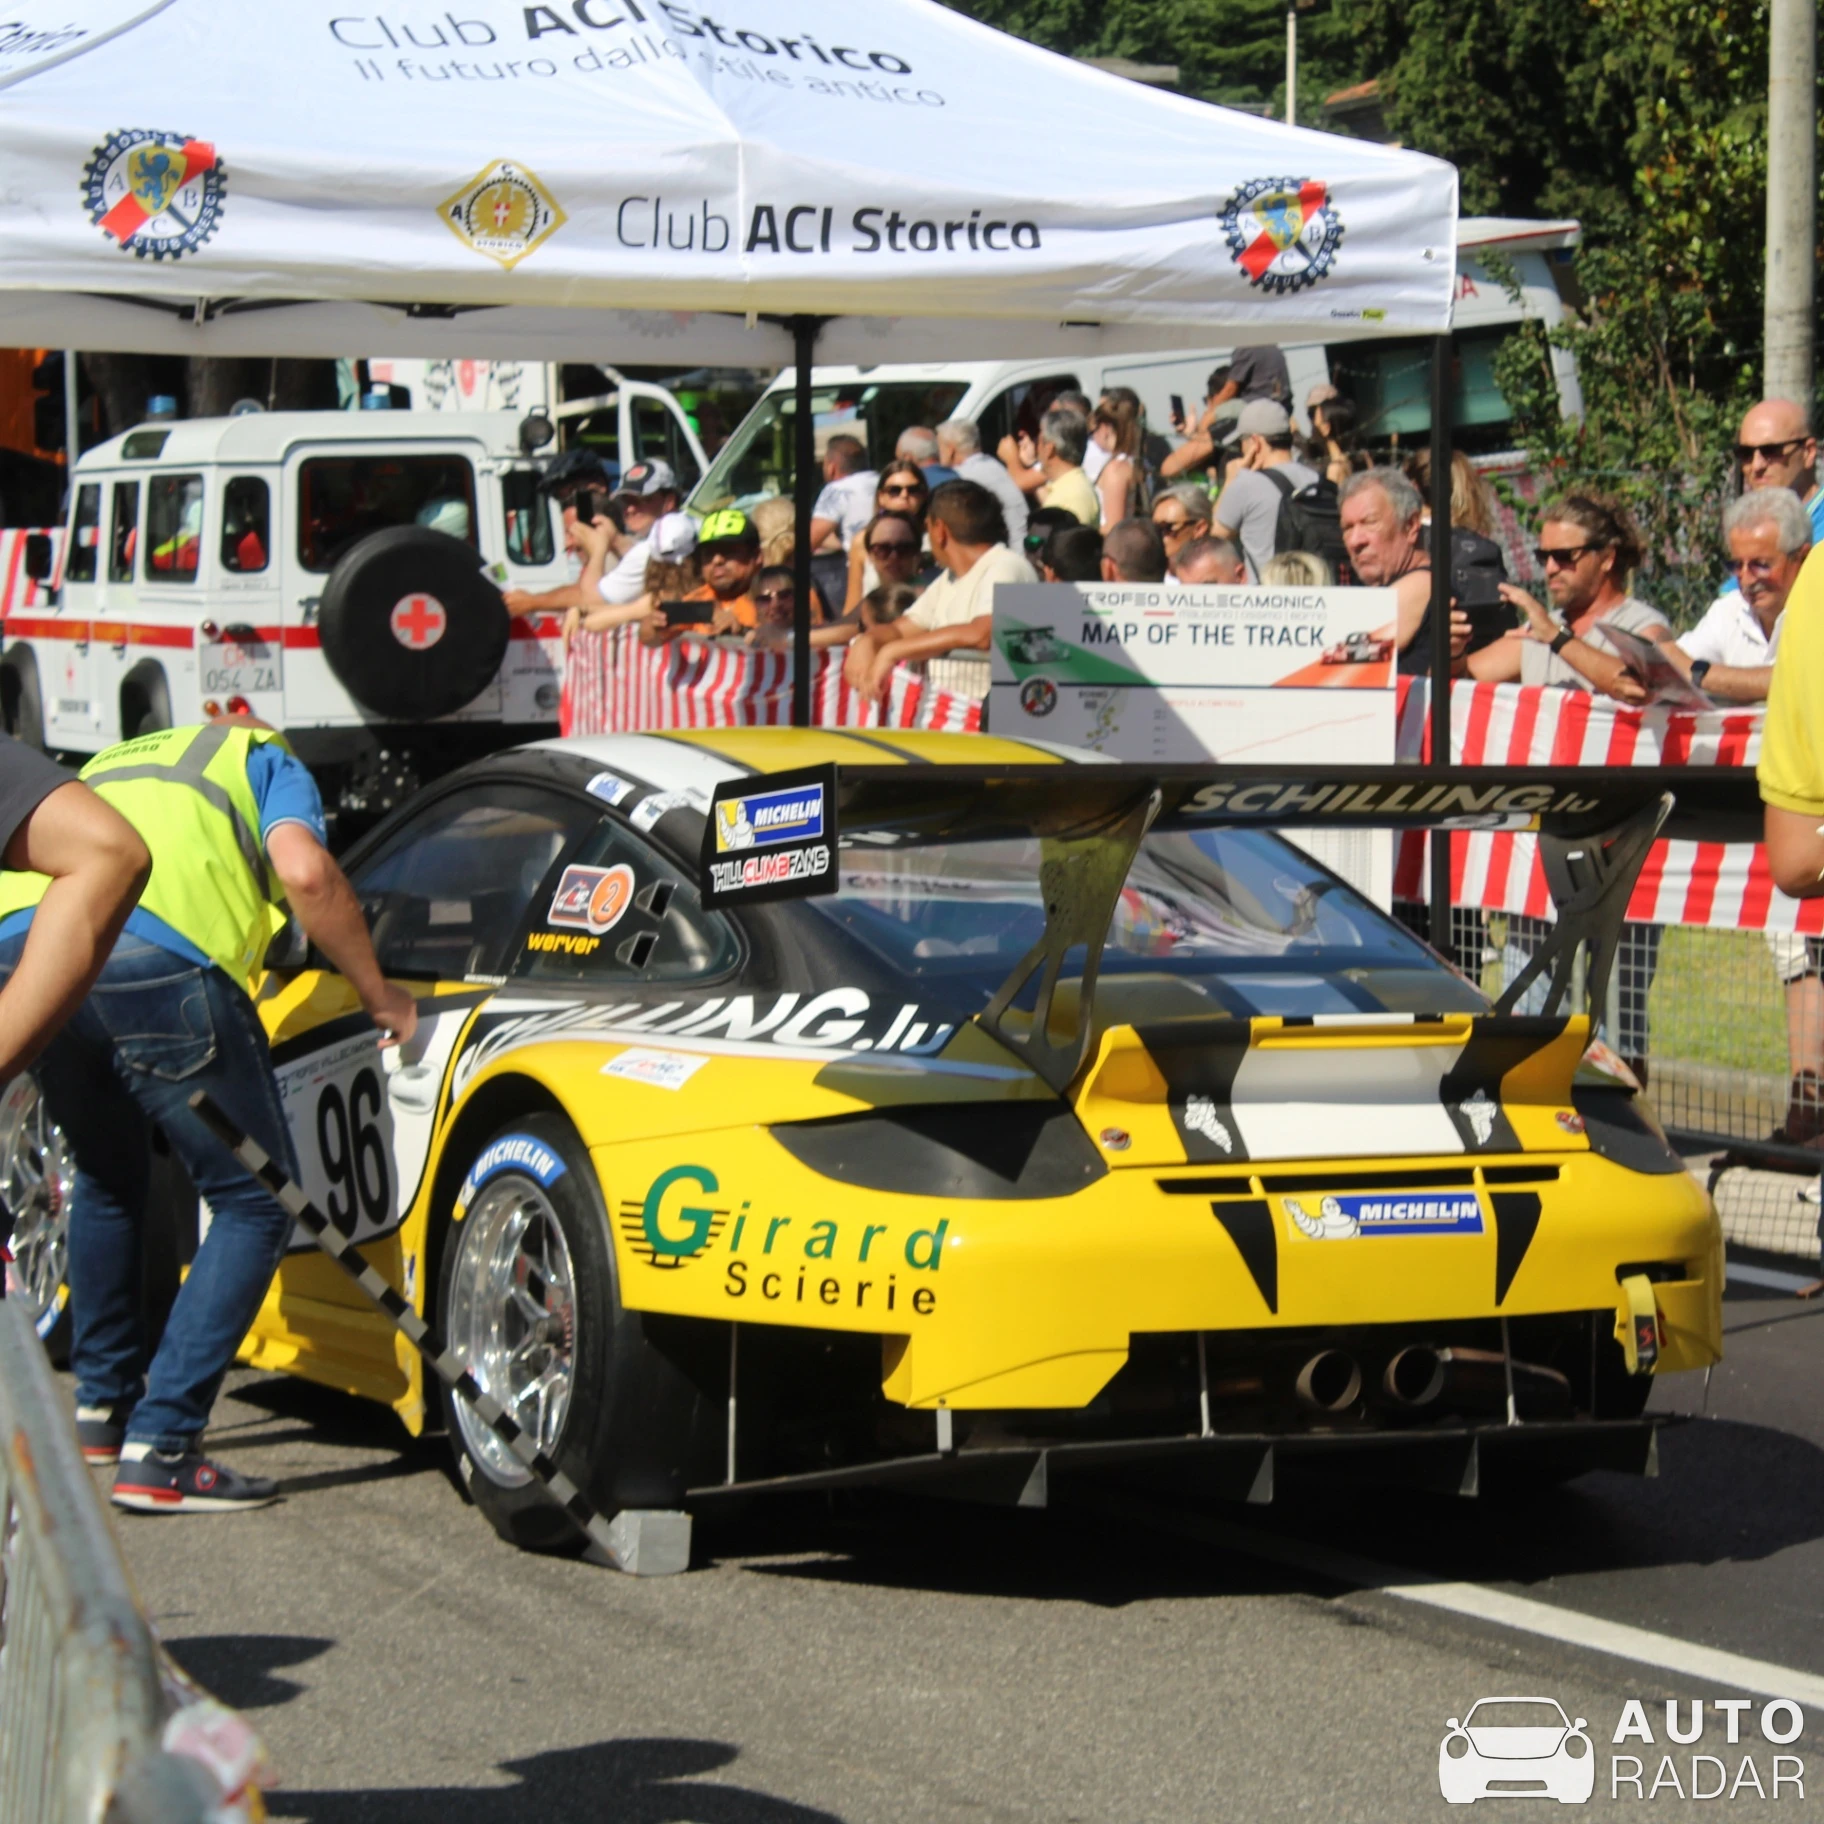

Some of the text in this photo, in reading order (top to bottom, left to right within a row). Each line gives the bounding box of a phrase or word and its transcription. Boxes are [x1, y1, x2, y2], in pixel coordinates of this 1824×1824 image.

[328, 0, 912, 74] Club ACI Storico
[354, 59, 385, 81] Il
[397, 58, 558, 82] futuro
[573, 34, 687, 73] dallo
[803, 75, 946, 107] antico
[616, 196, 1042, 254] Club ACI Storico
[134, 236, 181, 252] CLUB
[1081, 592, 1327, 610] TROFEO VALLECAMONICA
[1081, 622, 1326, 647] MAP OF THE TRACK
[253, 667, 276, 692] ZA
[753, 798, 822, 828] MICHELIN
[1179, 784, 1599, 814] SCHILLING.lu
[600, 881, 620, 913] 2
[316, 1066, 390, 1238] 96
[475, 1139, 556, 1182] MICHELIN
[642, 1163, 949, 1271] Girard
[1358, 1201, 1477, 1221] MICHELIN
[724, 1260, 937, 1316] Scierie
